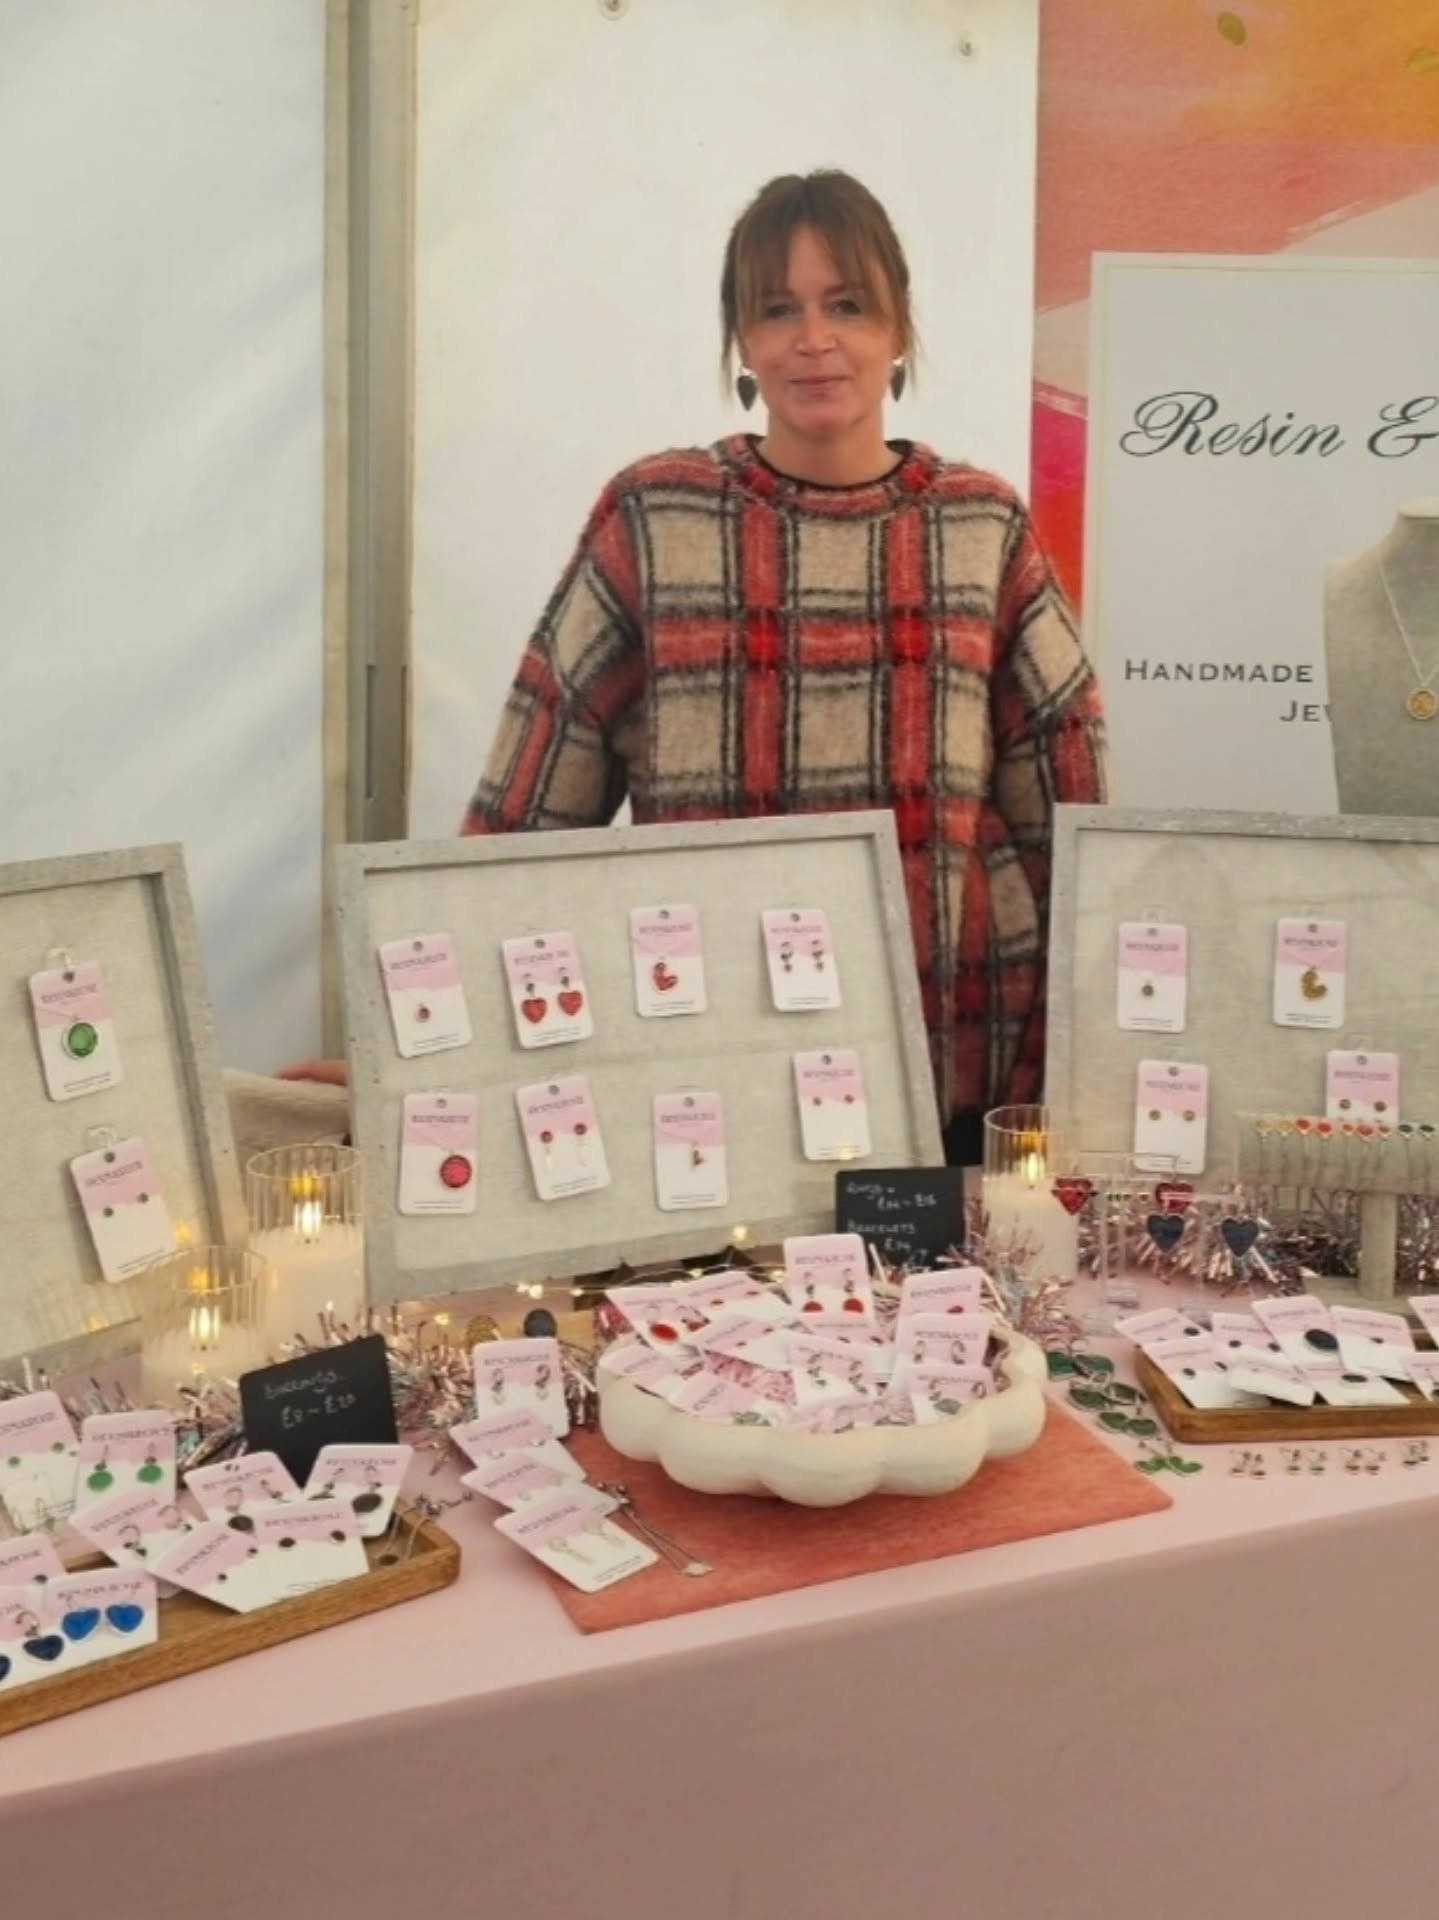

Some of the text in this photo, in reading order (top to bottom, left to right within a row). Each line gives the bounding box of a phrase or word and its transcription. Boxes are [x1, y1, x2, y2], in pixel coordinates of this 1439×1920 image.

[1119, 391, 1439, 458] Resin &
[1125, 659, 1313, 682] HANDMADE
